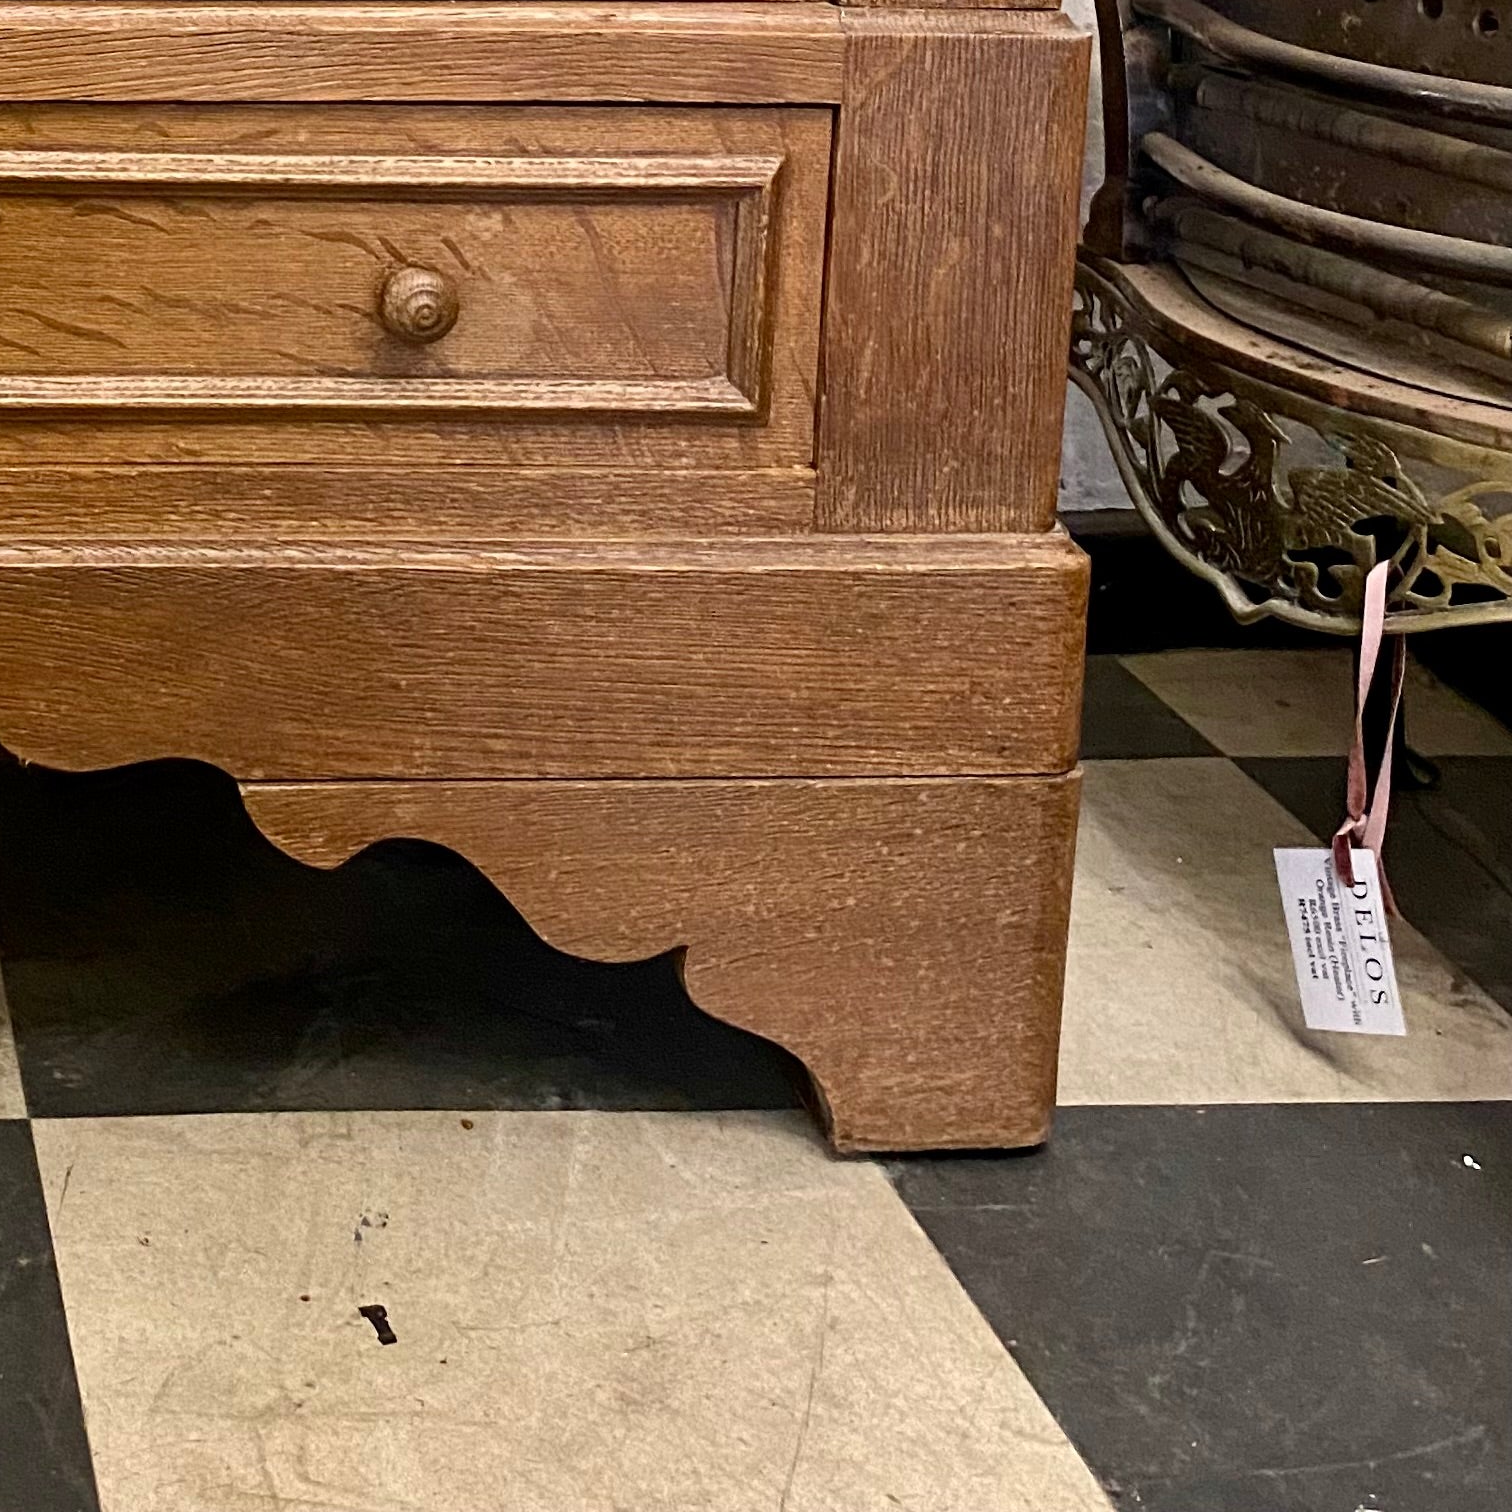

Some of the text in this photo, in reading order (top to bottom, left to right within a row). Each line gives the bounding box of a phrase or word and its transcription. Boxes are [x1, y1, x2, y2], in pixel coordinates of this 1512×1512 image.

[1315, 878, 1328, 917] Orange
[1308, 960, 1318, 979] vat
[1331, 902, 1343, 931] Brass
[1350, 1000, 1361, 1024] with
[1351, 880, 1388, 1005] DELOS
